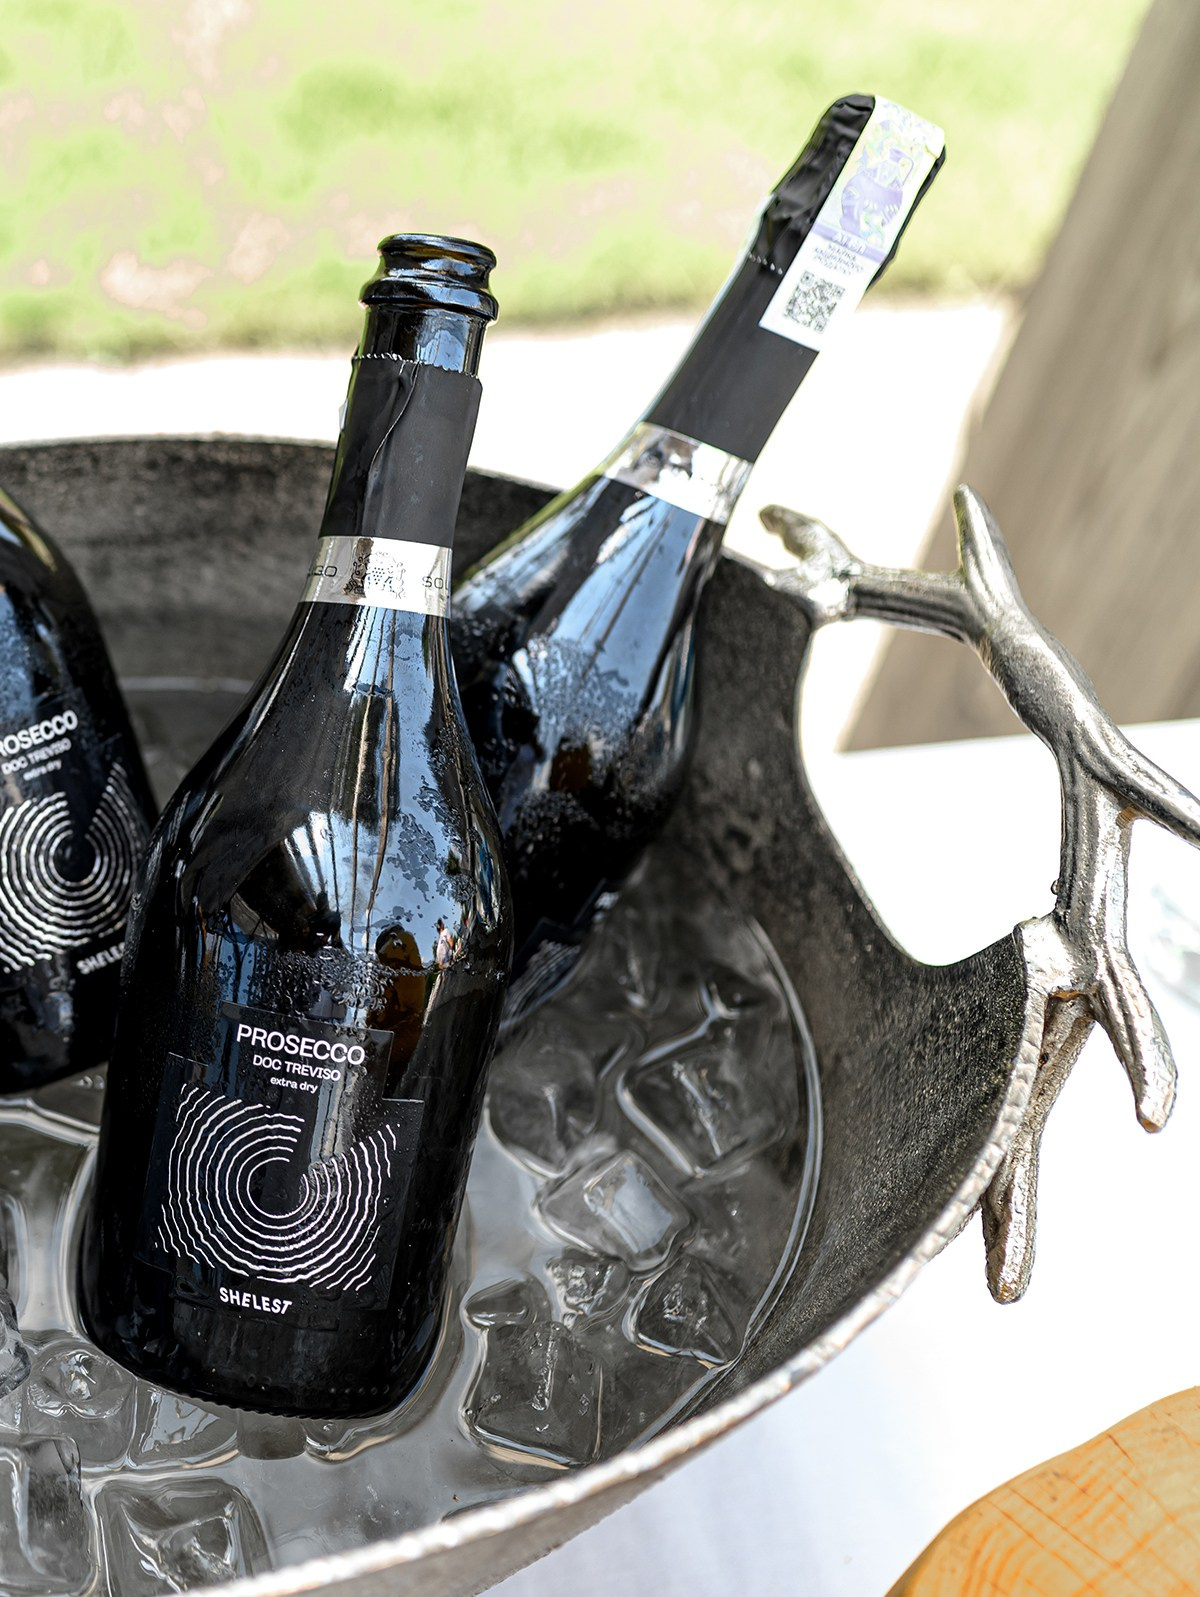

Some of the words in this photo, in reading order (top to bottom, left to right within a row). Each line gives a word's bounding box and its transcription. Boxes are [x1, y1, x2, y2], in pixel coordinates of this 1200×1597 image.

[1, 756, 28, 775] DOC
[27, 738, 72, 764] TREVISO
[236, 1023, 366, 1066] PROSECCO
[252, 1054, 282, 1071] DOC
[284, 1061, 341, 1082] TREVISO
[270, 1076, 298, 1090] extra
[299, 1081, 319, 1094] dry
[219, 1287, 293, 1316] SHELEST
